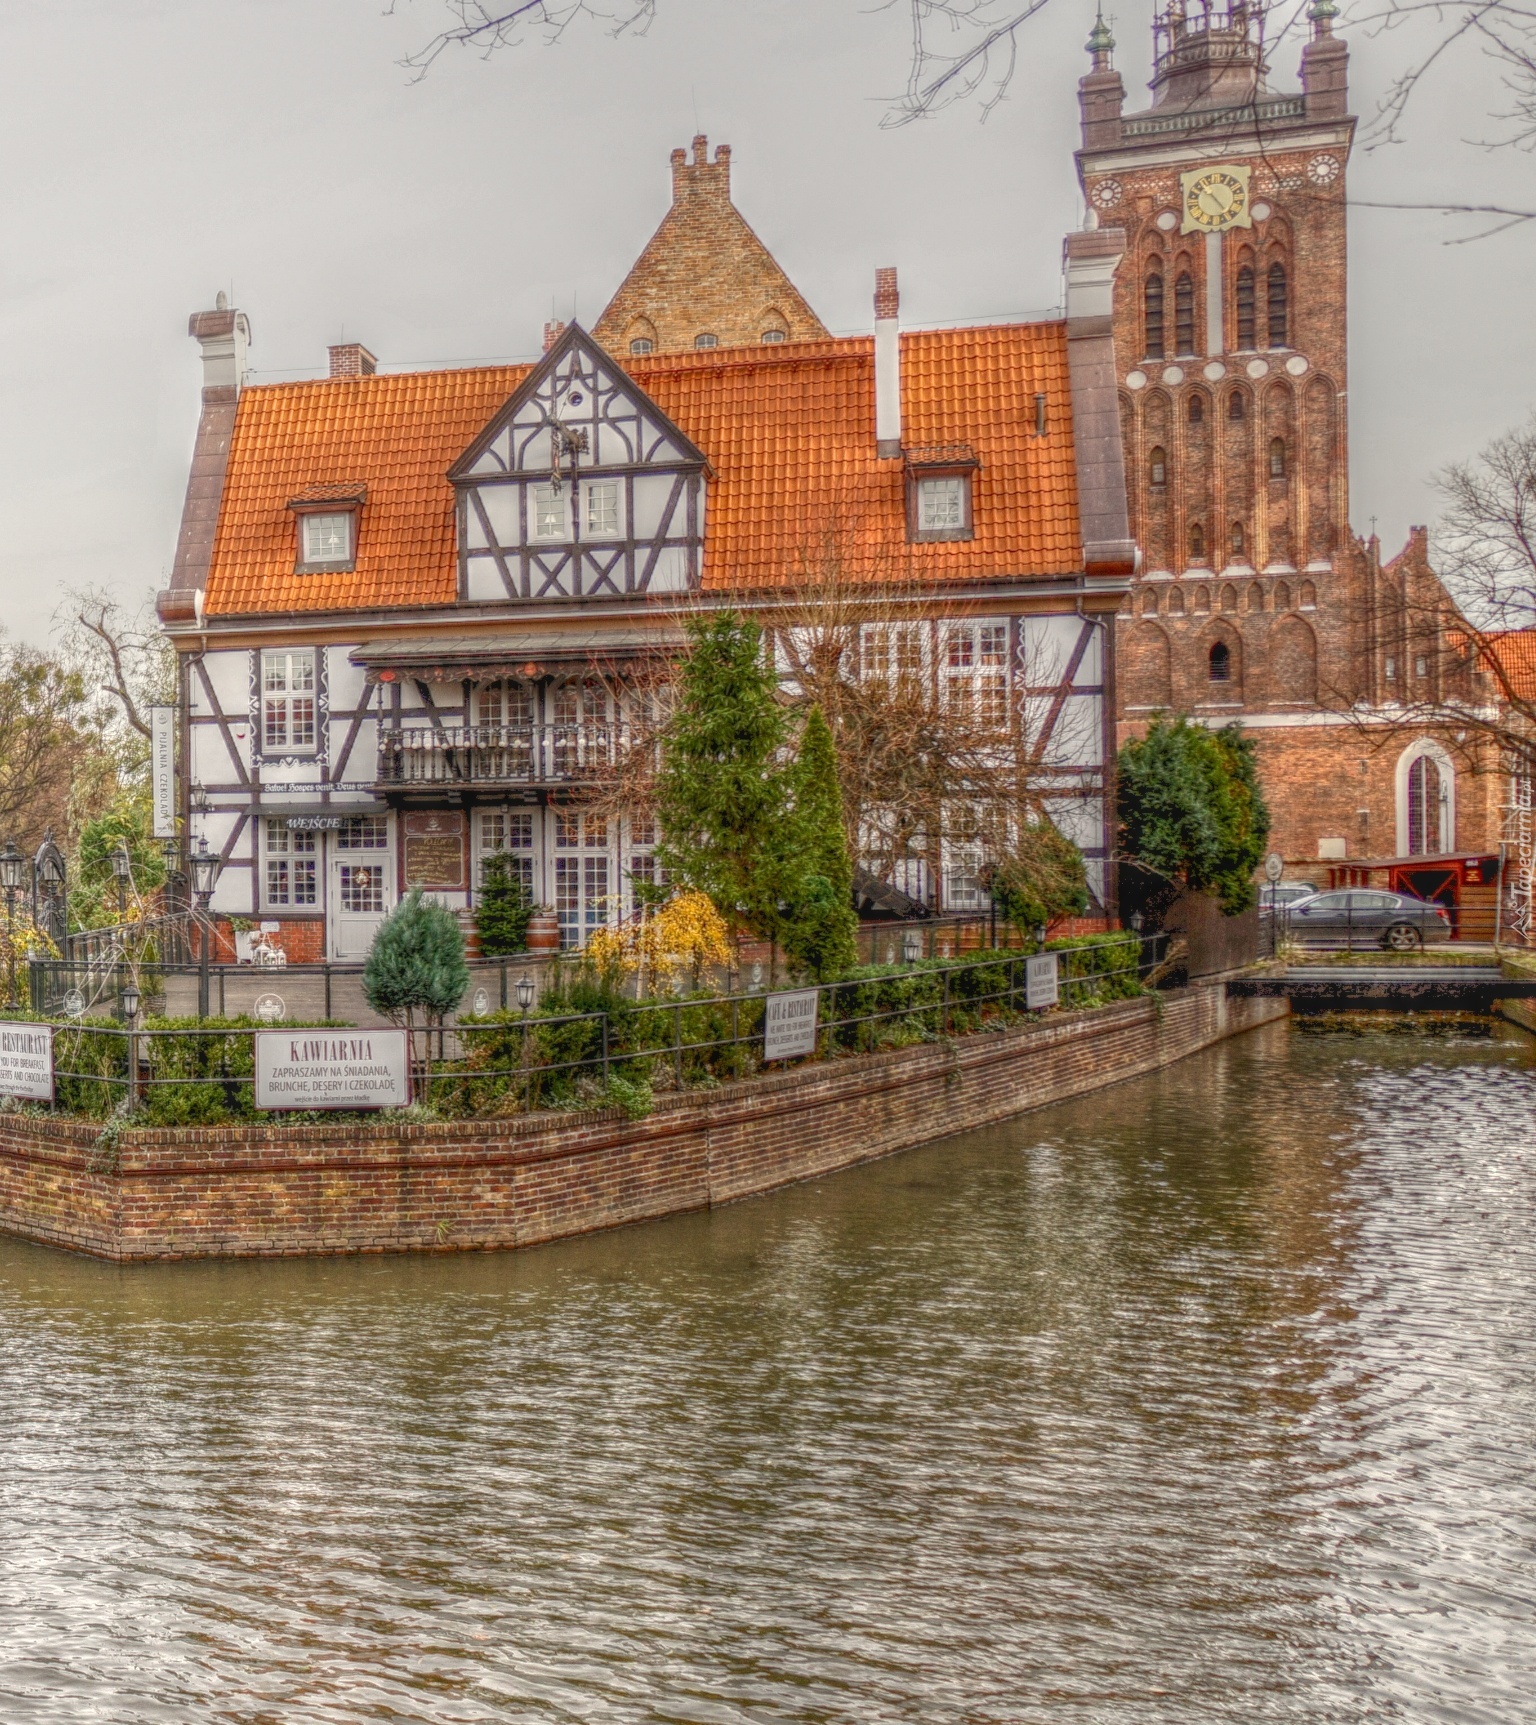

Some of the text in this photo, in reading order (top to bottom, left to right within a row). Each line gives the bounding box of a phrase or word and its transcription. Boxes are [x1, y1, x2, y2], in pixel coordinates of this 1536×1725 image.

[159, 731, 168, 769] PIJALNIA
[159, 773, 169, 820] CZEKOLADY
[287, 815, 340, 829] WEJŚCIE
[2, 1032, 48, 1055] RESTAURANT
[290, 1039, 373, 1061] KAWIARNIA
[0, 1056, 10, 1067] YOU
[10, 1057, 19, 1067] FOR
[14, 1071, 24, 1081] AND
[272, 1064, 391, 1078] ZAPRASZAMY NA ŚNIADANIA,
[268, 1079, 396, 1093] BRUNCHE, DESERY I CZEKOLADĘ
